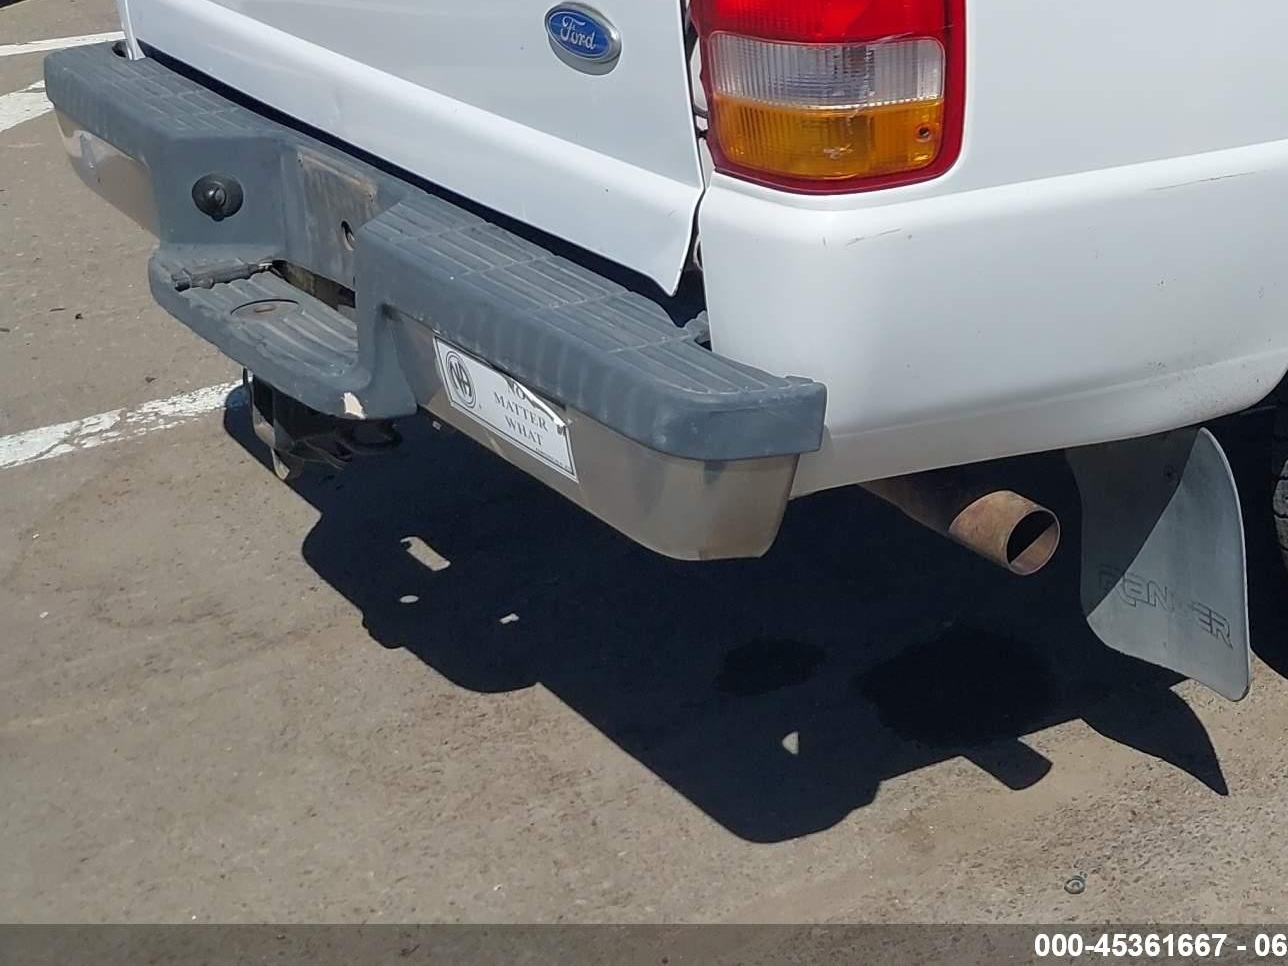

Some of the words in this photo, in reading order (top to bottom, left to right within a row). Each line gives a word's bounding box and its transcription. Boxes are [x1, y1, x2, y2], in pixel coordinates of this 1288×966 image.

[559, 15, 597, 50] Ford
[493, 391, 549, 433] MATTER
[504, 414, 544, 446] WHAT
